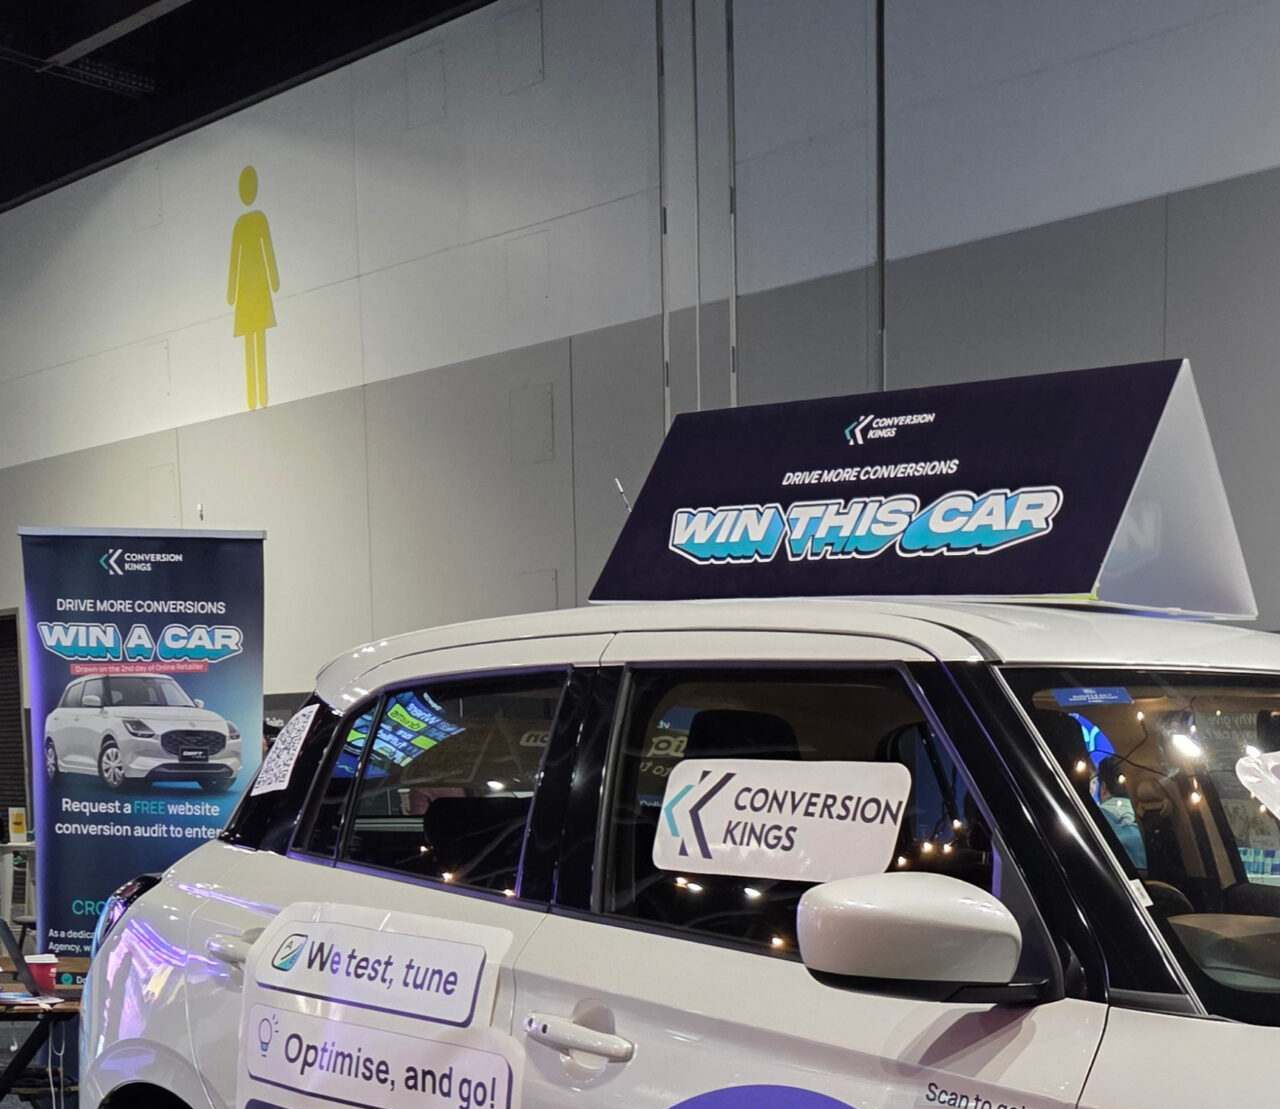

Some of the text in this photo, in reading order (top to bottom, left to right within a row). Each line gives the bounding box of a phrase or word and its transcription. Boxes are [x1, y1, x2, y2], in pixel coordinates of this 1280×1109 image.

[873, 413, 935, 427] CONVERSION
[867, 426, 897, 438] KINGS
[782, 459, 959, 485] DRIVE MORE CONVERSIONS
[671, 507, 782, 560] WIN
[787, 497, 915, 558] THIS
[908, 490, 1060, 553] CAR
[124, 552, 183, 563] CONVERSION
[124, 563, 152, 572] KINGS
[57, 599, 226, 614] DRIVE MORE CONVERSIONS
[39, 623, 242, 660] WIN A CAR
[62, 798, 220, 817] Request a FREE website
[733, 786, 903, 827] CONVERSION
[55, 821, 223, 839] conversion audit to enter
[723, 820, 797, 852] KINGS
[49, 929, 59, 938] As
[48, 942, 83, 952] Agency,
[307, 941, 458, 996] We test, tune
[284, 1033, 395, 1091] Optimise,
[404, 1064, 452, 1098] and
[926, 1083, 970, 1109] Scan
